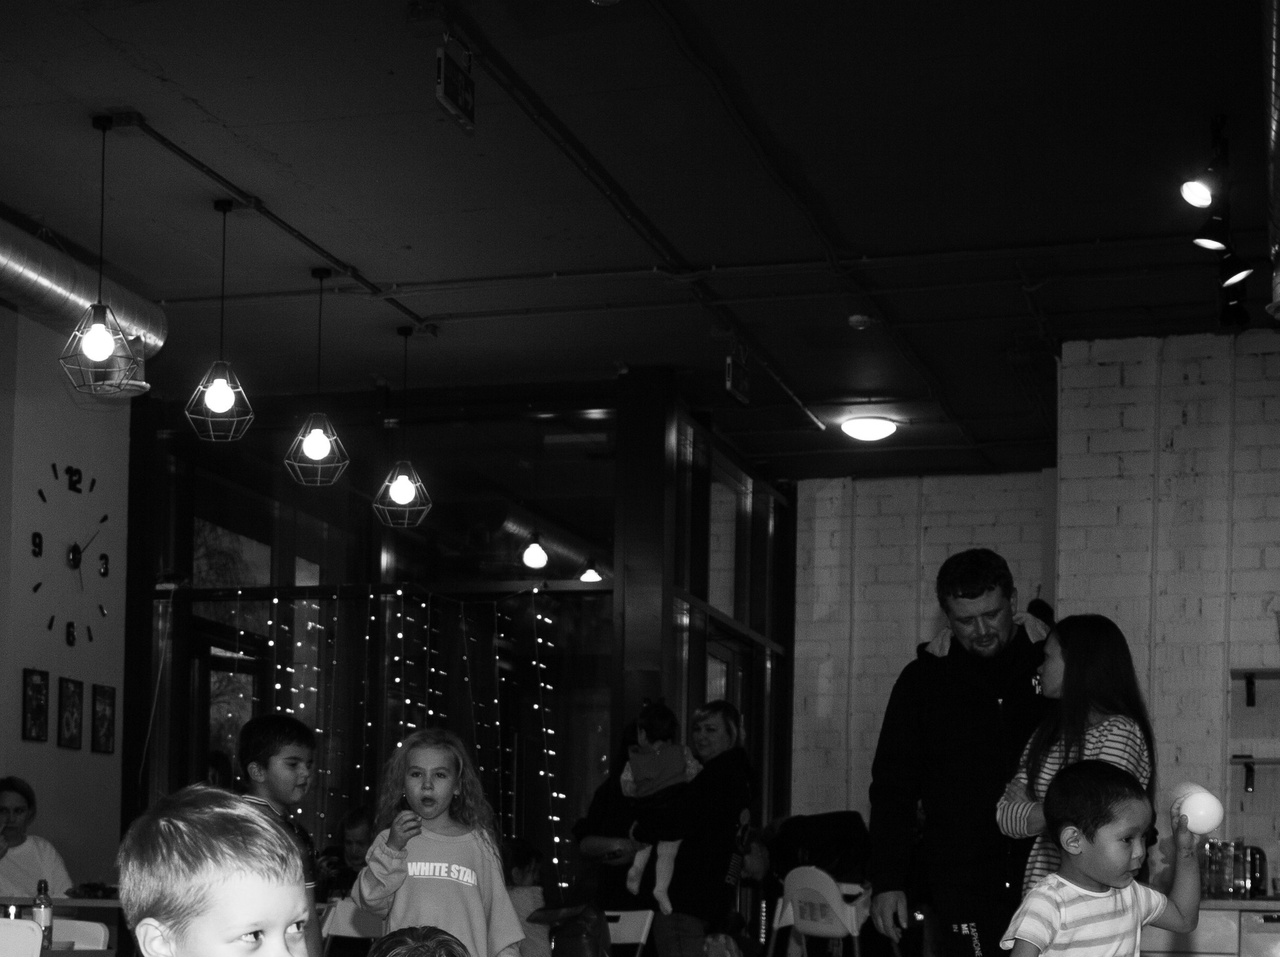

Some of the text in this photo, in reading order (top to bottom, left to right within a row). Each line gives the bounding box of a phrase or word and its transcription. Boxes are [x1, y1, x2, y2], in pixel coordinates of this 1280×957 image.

[65, 465, 83, 494] 12
[31, 531, 43, 558] 9
[99, 553, 109, 578] 3
[65, 621, 76, 647] 6
[407, 861, 449, 877] WHITE
[960, 923, 970, 936] ME
